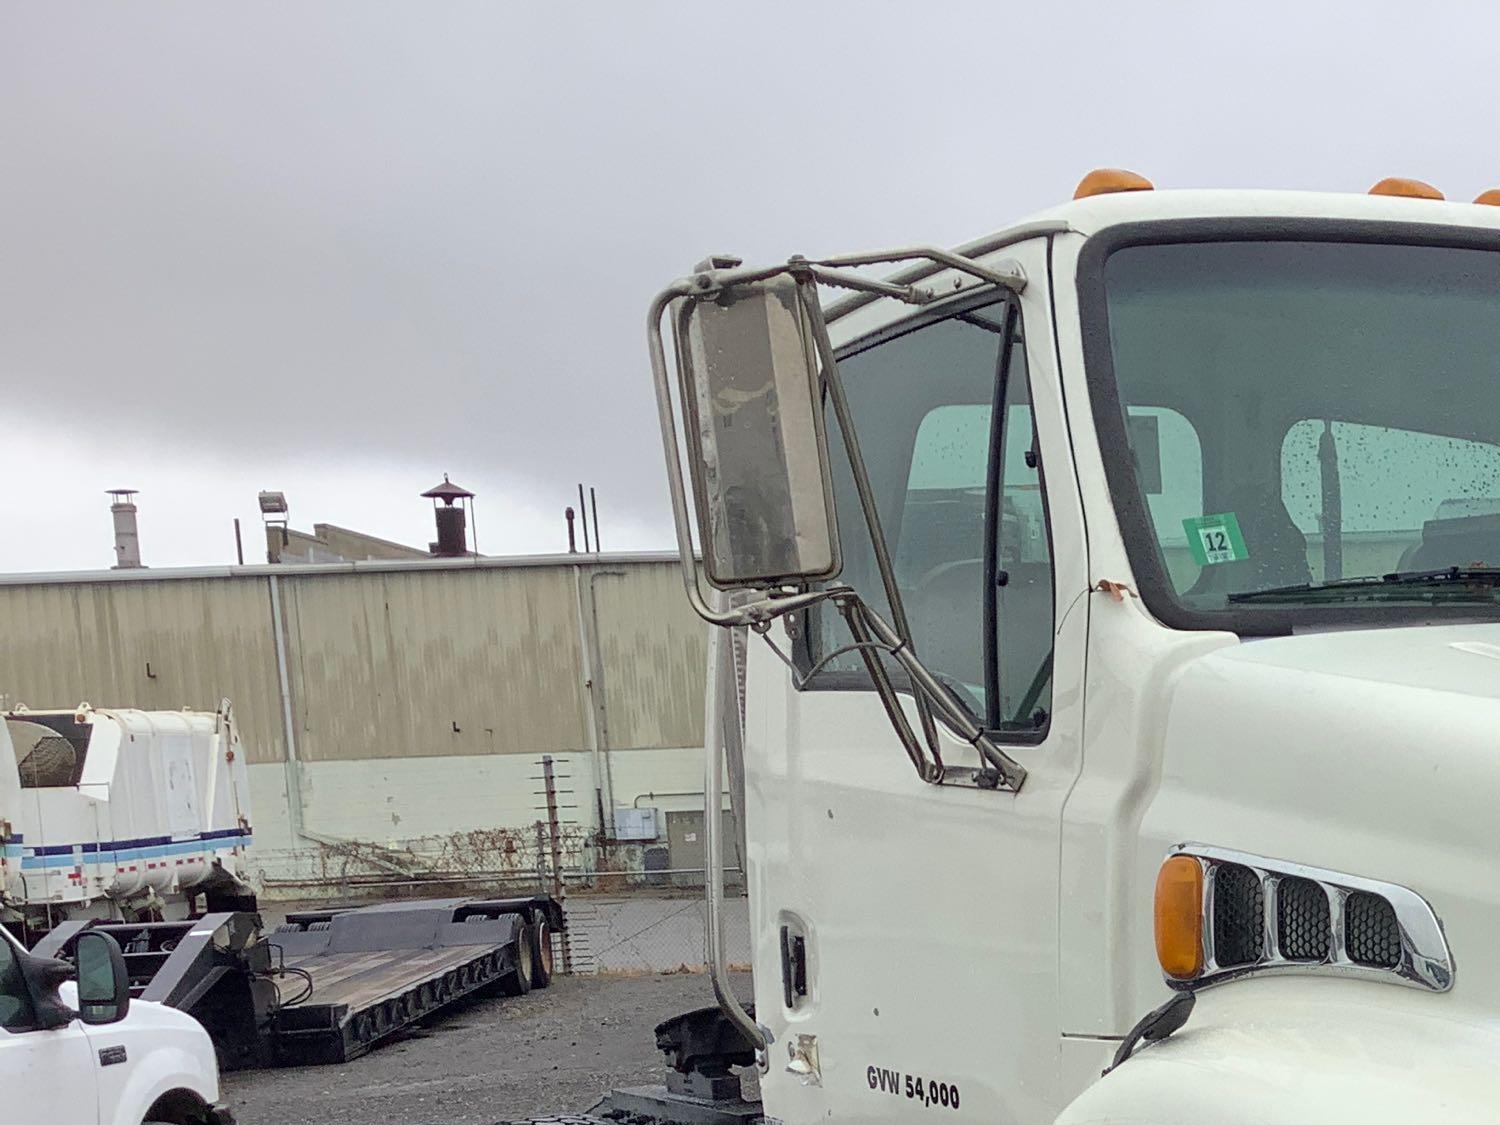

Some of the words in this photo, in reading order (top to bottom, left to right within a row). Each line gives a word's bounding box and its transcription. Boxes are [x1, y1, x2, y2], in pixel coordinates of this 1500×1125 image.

[1206, 532, 1227, 551] 12
[867, 1066, 899, 1095] GVW
[905, 1074, 959, 1109] 54,000
